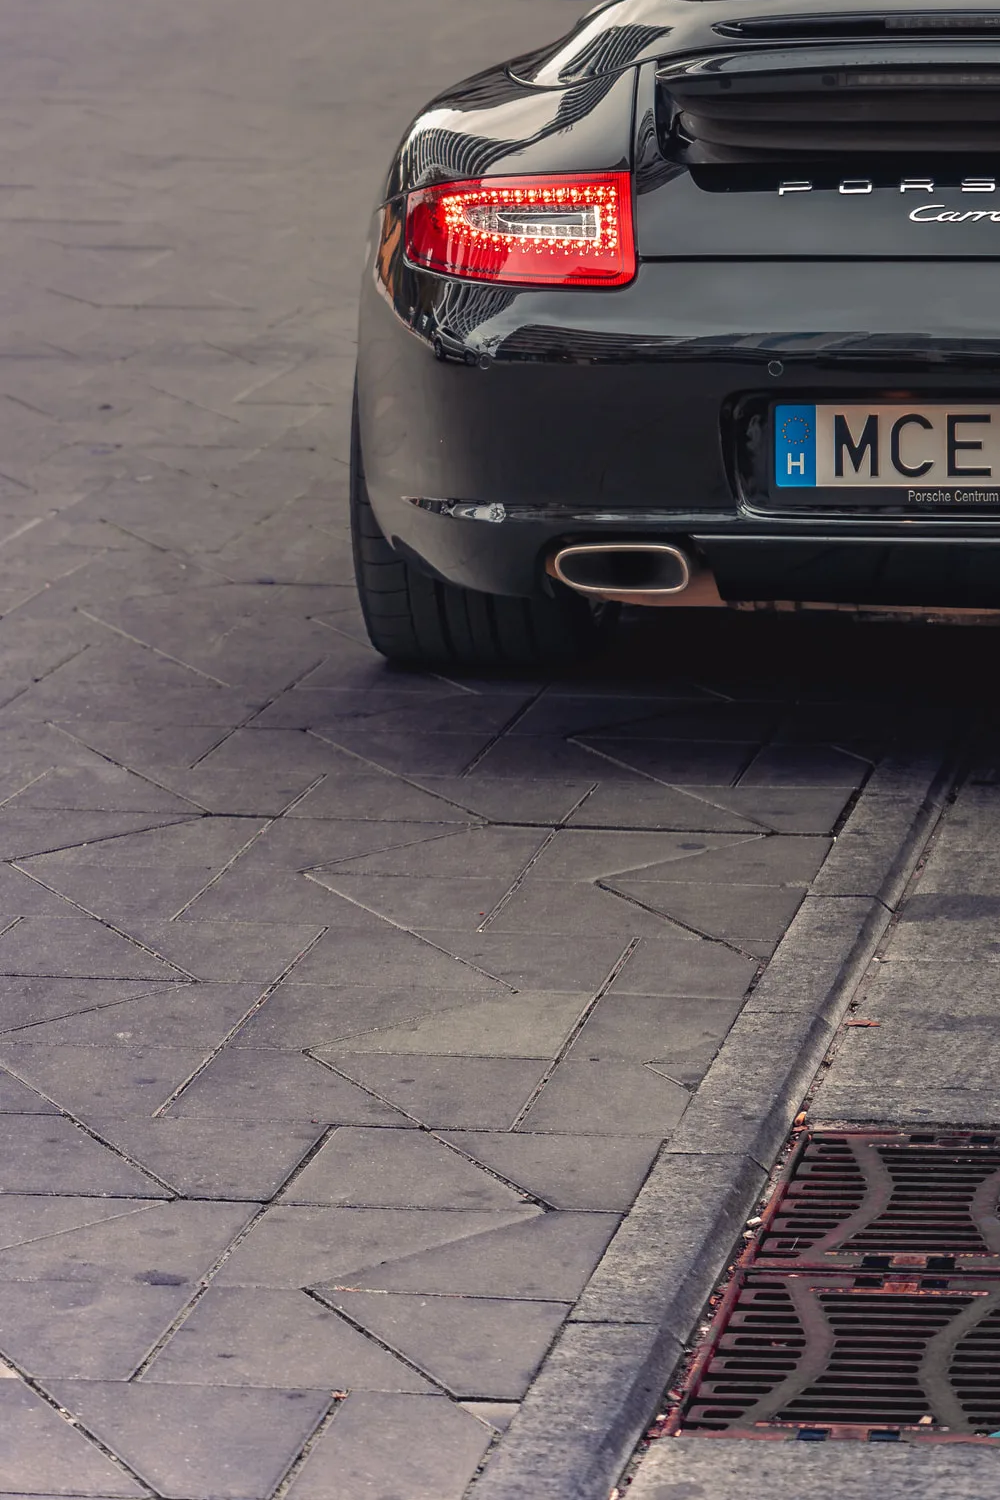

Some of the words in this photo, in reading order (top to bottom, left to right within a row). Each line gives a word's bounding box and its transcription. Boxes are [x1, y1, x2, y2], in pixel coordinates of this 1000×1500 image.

[786, 452, 806, 476] H
[907, 489, 952, 503] Porsche
[953, 489, 999, 503] Centrum
